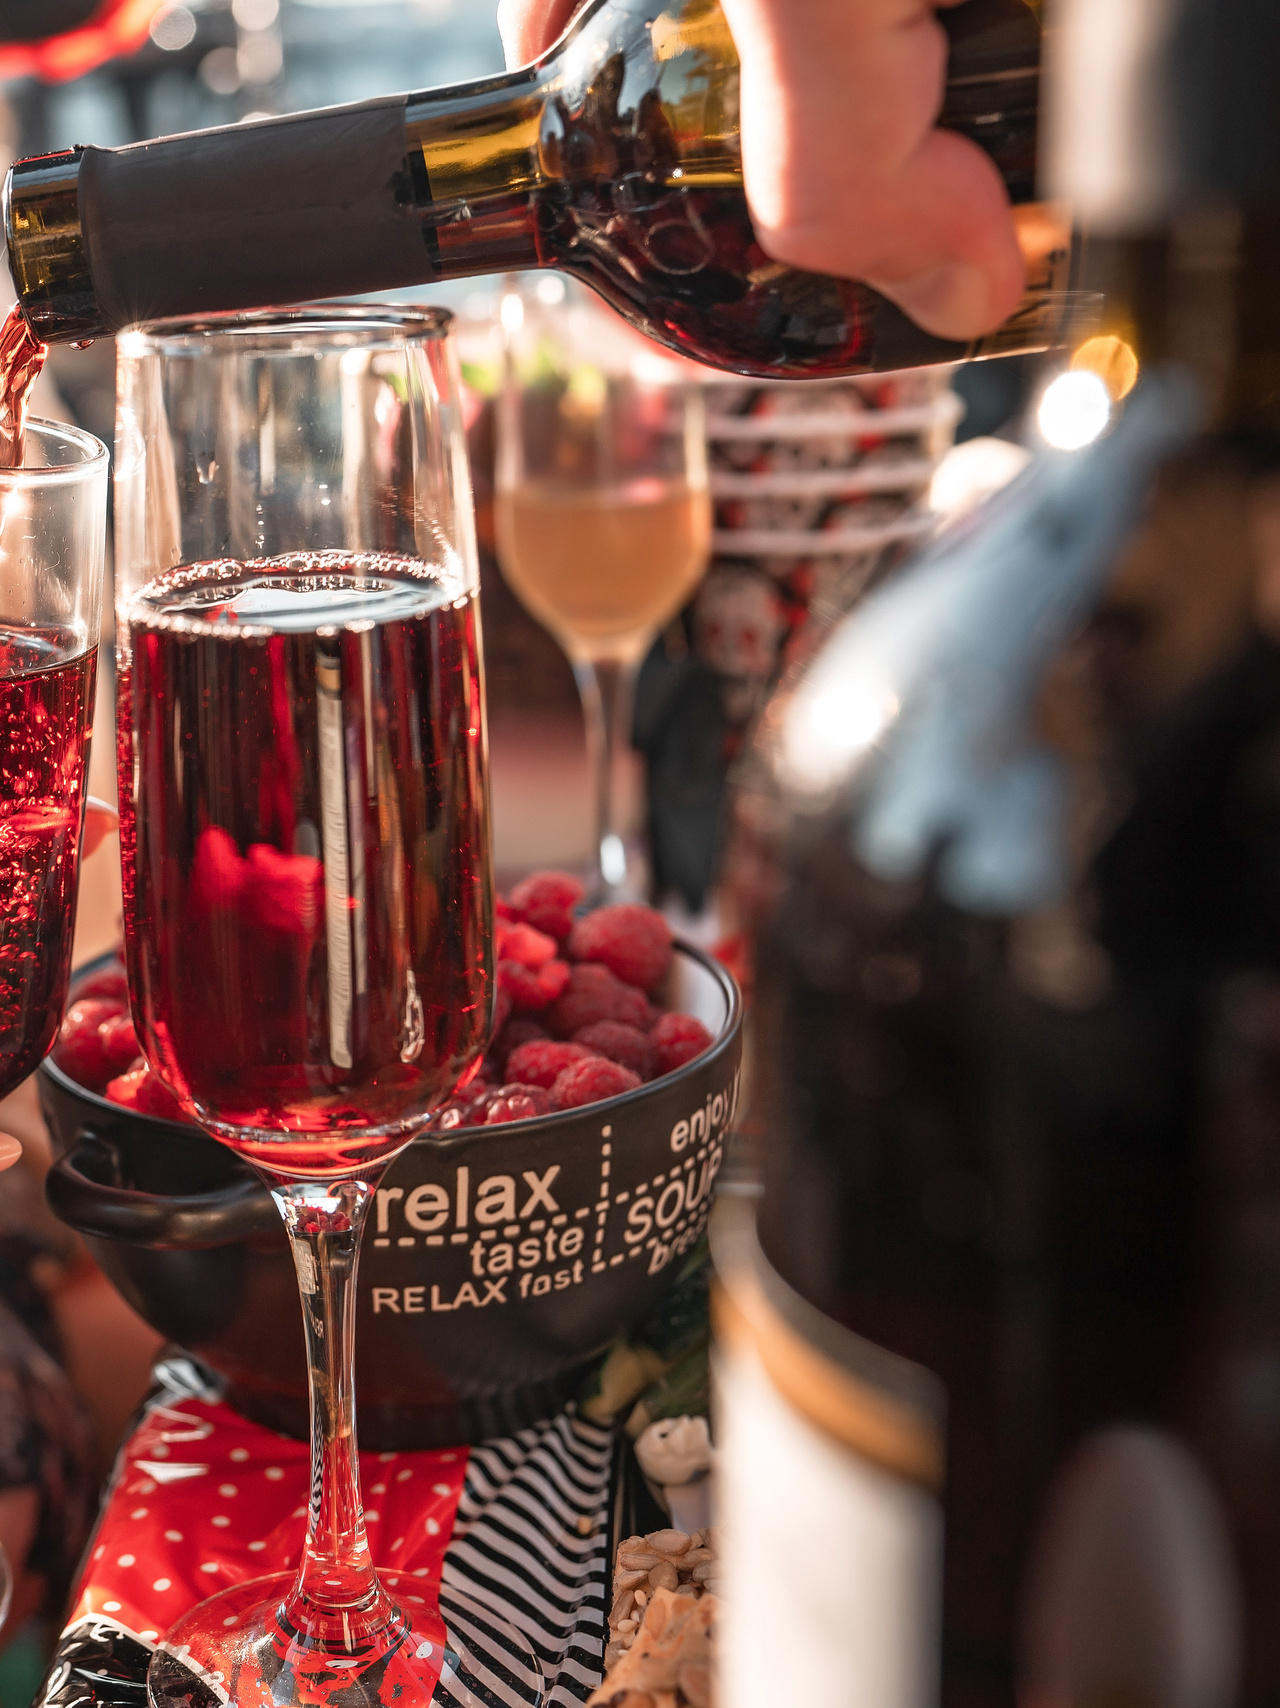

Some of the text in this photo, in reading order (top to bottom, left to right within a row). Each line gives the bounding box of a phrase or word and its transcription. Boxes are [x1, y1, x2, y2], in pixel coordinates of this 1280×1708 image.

[376, 1165, 561, 1233] relax
[624, 1145, 722, 1244] SOUP
[470, 1227, 584, 1276] taste
[372, 1259, 584, 1314] RELAX fast
